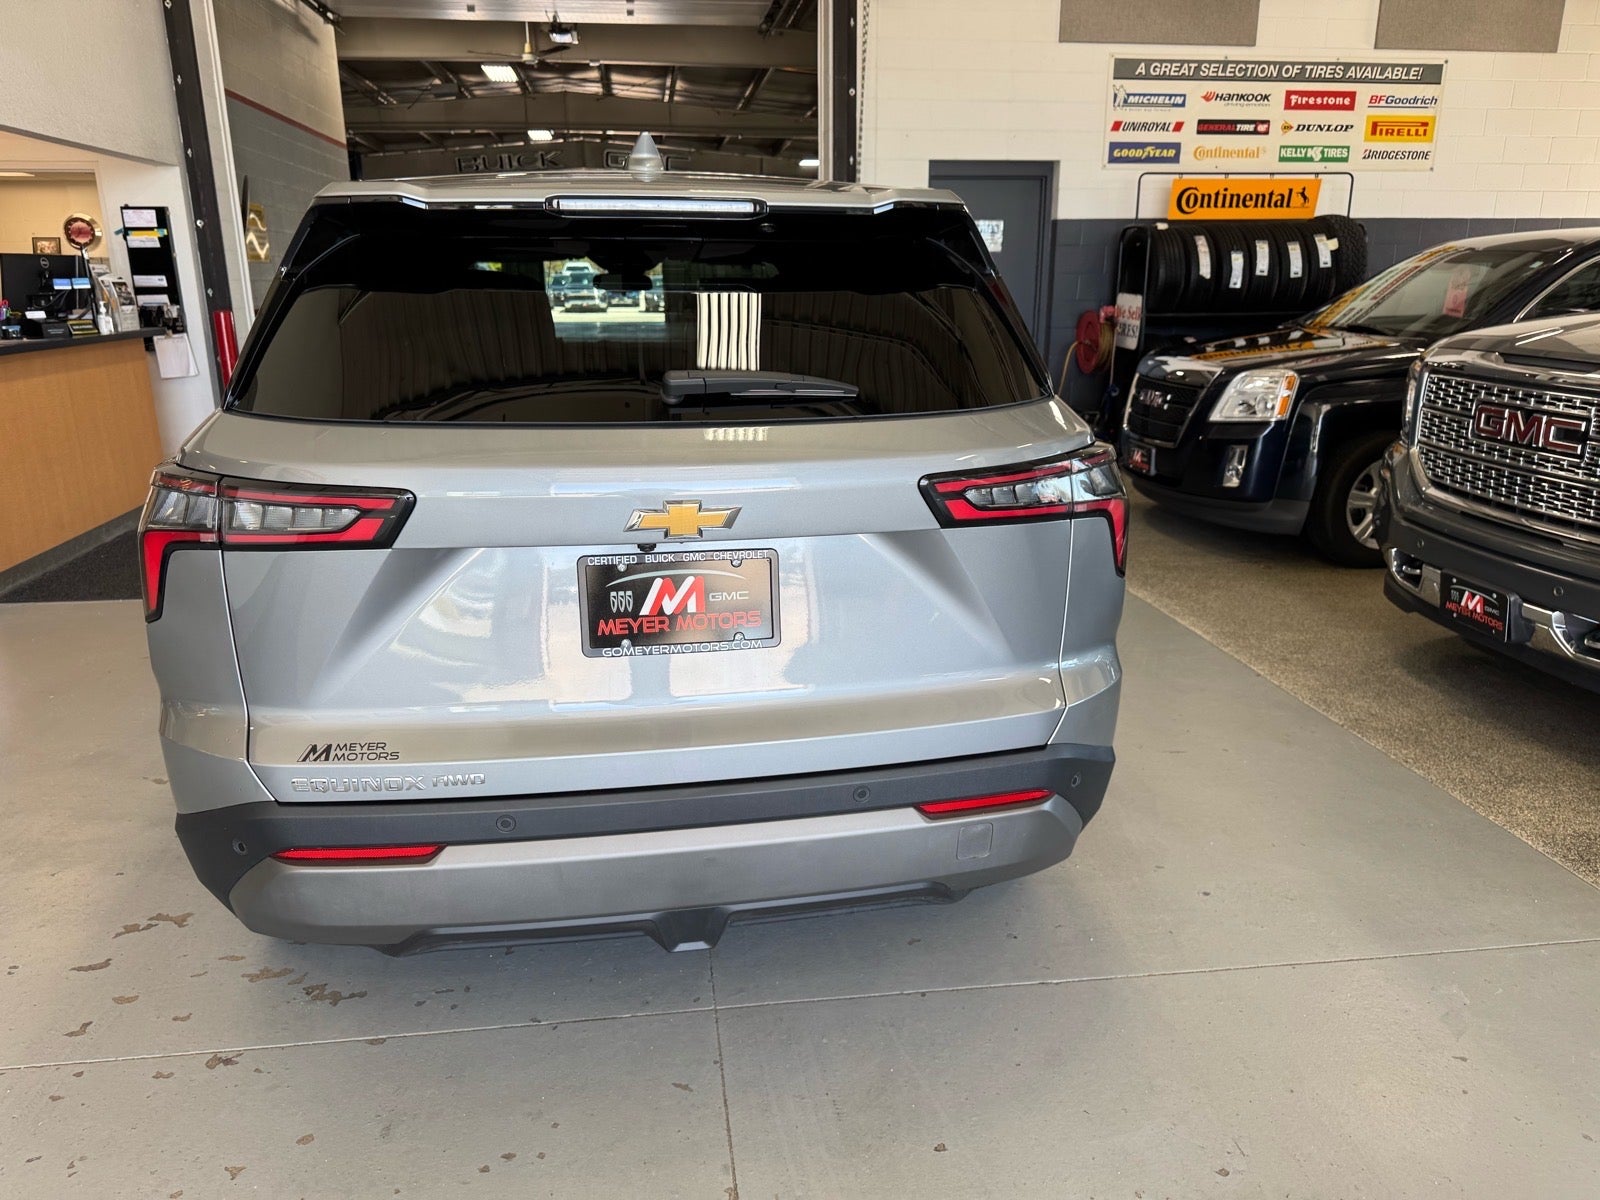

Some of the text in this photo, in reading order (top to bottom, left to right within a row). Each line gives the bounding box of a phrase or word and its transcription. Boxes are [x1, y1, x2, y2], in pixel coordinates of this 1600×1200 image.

[1136, 62, 1424, 80] A GREAT SELECTION OF TIRES AVAILABLE!
[1127, 95, 1184, 105] MICHELIN
[1289, 94, 1351, 107] Firestone
[1368, 94, 1438, 106] BFGoodrich
[1122, 121, 1172, 132] UNIROYAL
[1198, 123, 1235, 132] GENERAL
[1235, 123, 1256, 132] TIRE
[1295, 124, 1354, 132] DUNLOP
[1370, 121, 1429, 137] PIRELLI
[1113, 146, 1176, 160] GOODYEAR
[1193, 144, 1260, 161] Continental
[1280, 147, 1307, 158] KELLY
[1324, 147, 1349, 158] TIRES
[1362, 149, 1432, 161] BRIDGESTONE
[455, 148, 691, 173] BUICK GC
[1176, 186, 1294, 215] Continental
[1474, 404, 1586, 455] GMC
[587, 550, 769, 566] CERTIFIED BUICK GMC CHEVROLET
[709, 591, 749, 601] GMC
[1445, 600, 1504, 631] MEYER MOTORS
[597, 610, 762, 636] MEYER MOTORS
[602, 639, 763, 658] GOMEYERMOTORS.COM
[334, 742, 387, 751] MEYER
[332, 751, 400, 762] MOTORS
[291, 773, 486, 793] EQUINOX AWD
